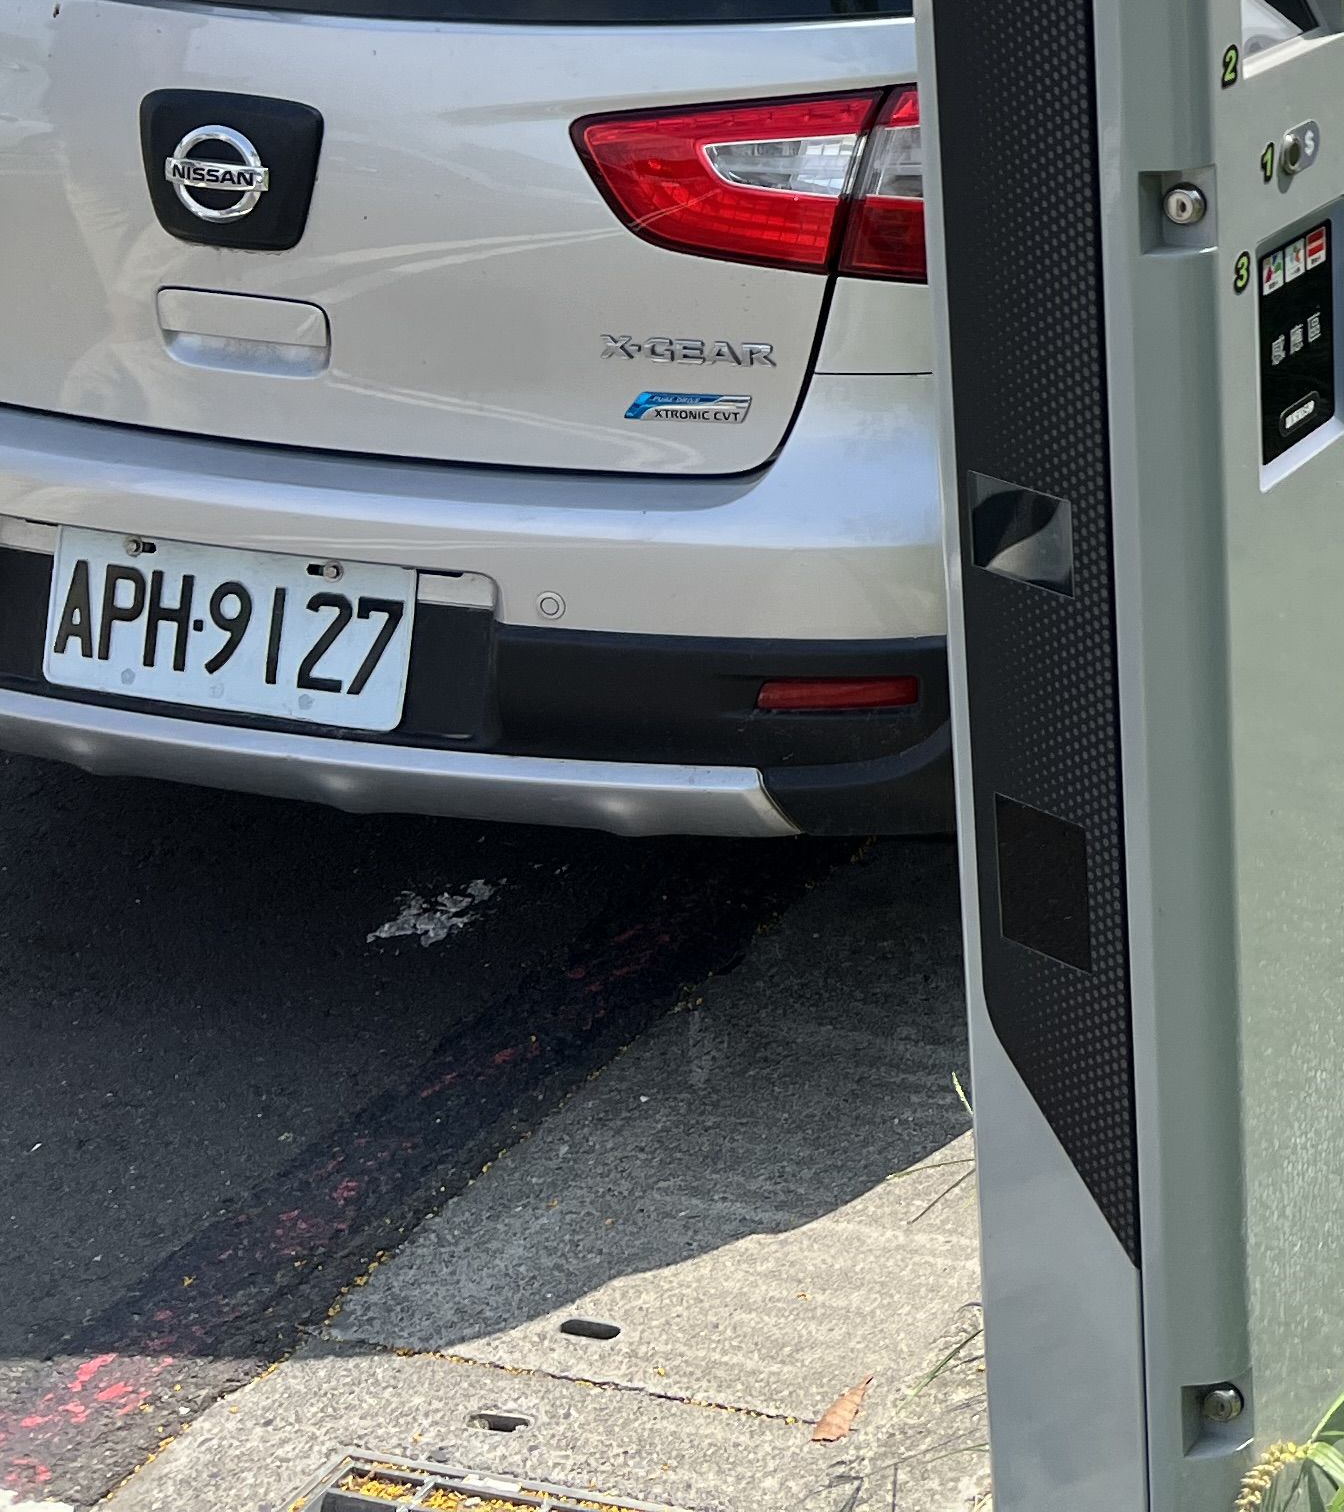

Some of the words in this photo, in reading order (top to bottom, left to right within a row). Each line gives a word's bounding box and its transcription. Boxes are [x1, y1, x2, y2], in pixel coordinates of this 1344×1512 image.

[1222, 46, 1238, 87] 2
[172, 164, 254, 186] NISSAN
[1262, 143, 1274, 179] 1
[1234, 252, 1250, 291] 3
[600, 334, 777, 368] X-GEAR
[654, 408, 710, 420] XTRONIC
[713, 410, 740, 422] CVT
